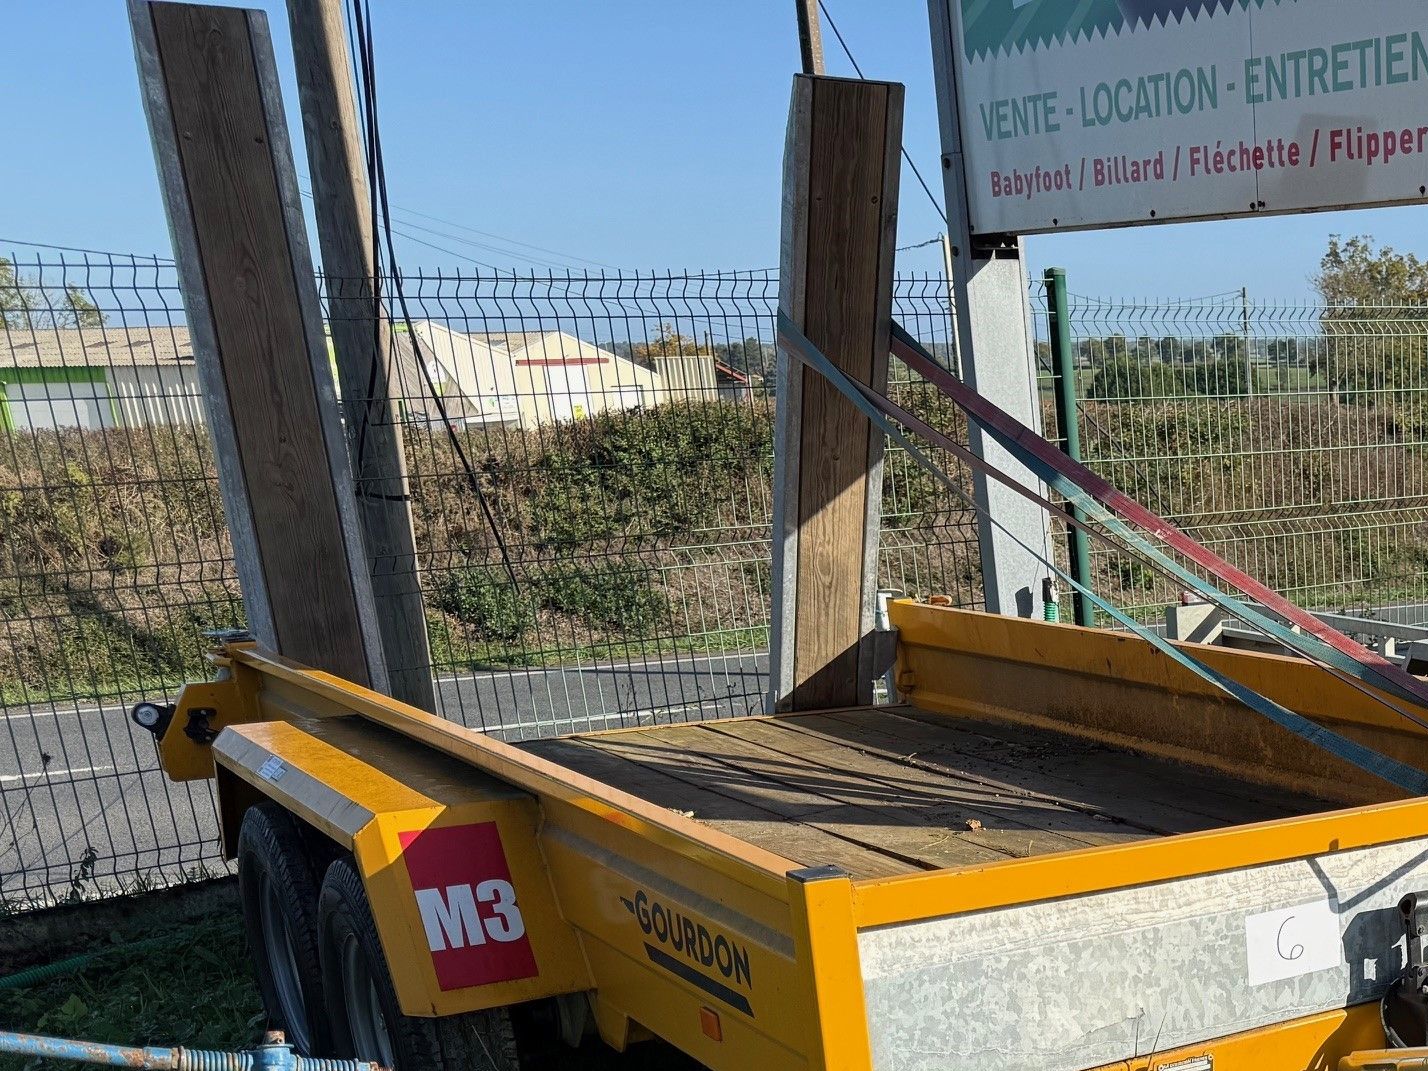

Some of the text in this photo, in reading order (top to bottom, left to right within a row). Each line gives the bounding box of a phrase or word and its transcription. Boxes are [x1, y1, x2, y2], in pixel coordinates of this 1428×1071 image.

[979, 91, 1061, 142] VENTE
[1080, 64, 1218, 128] LOCATION
[990, 161, 1073, 199] Babyfoot
[1093, 149, 1165, 185] Billard
[1188, 139, 1302, 177] Fléchette
[414, 878, 526, 953] M3
[633, 888, 754, 991] GOURDON
[1276, 915, 1305, 961] 6
